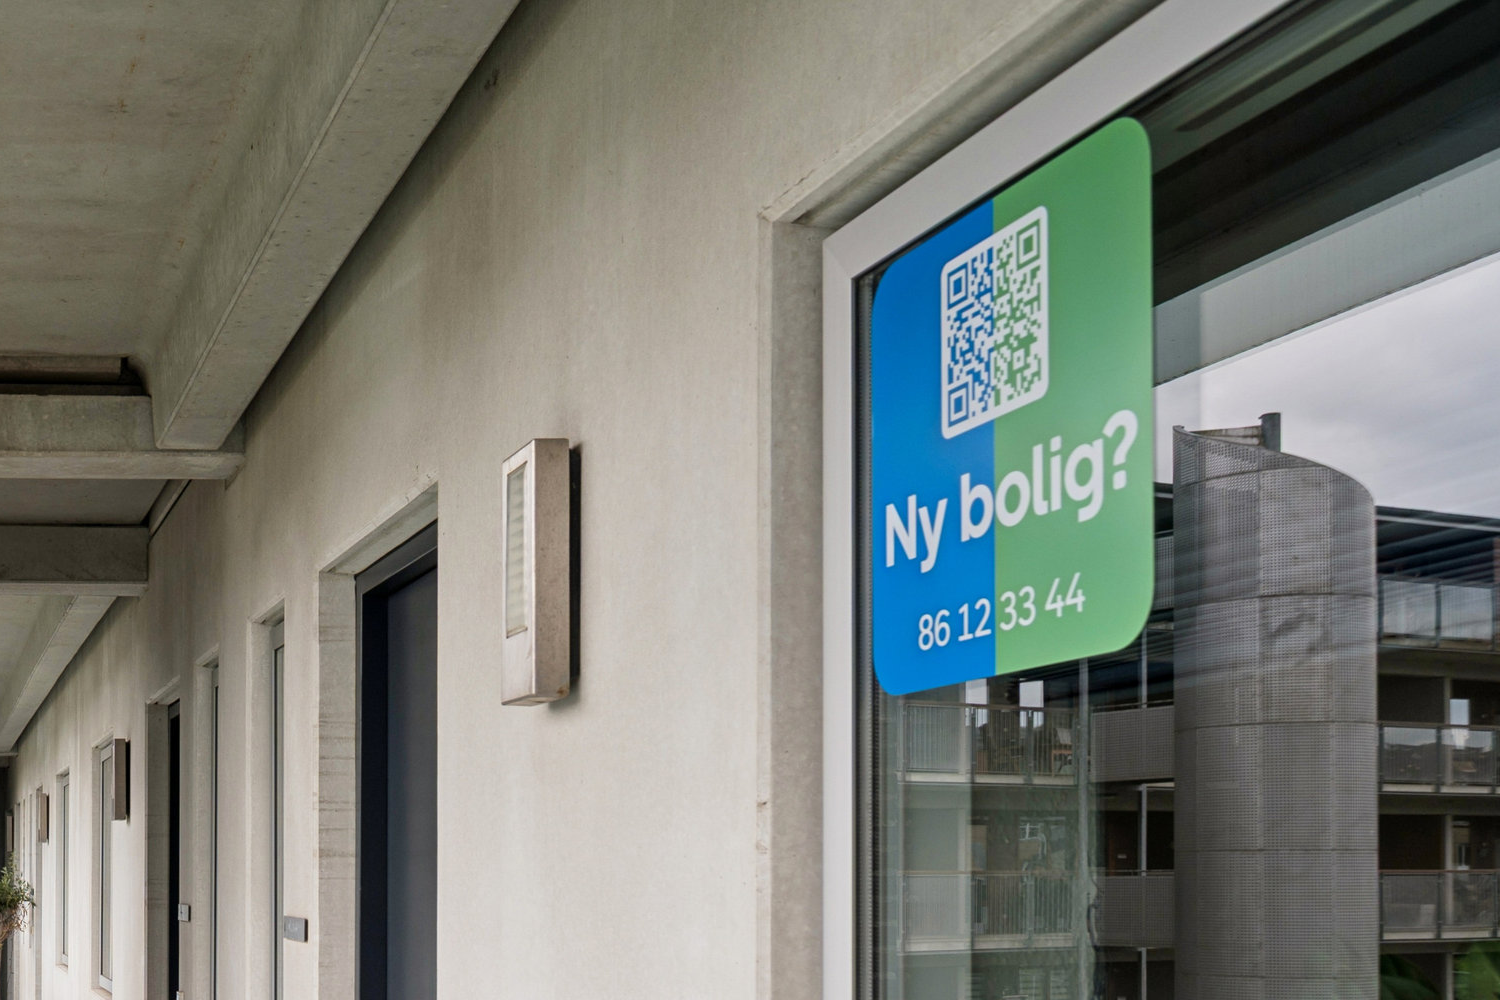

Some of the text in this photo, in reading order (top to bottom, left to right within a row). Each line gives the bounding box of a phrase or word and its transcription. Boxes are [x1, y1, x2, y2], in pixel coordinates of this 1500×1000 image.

[885, 409, 1140, 574] Ny bolig?
[917, 571, 1087, 652] 86 12 33 44
